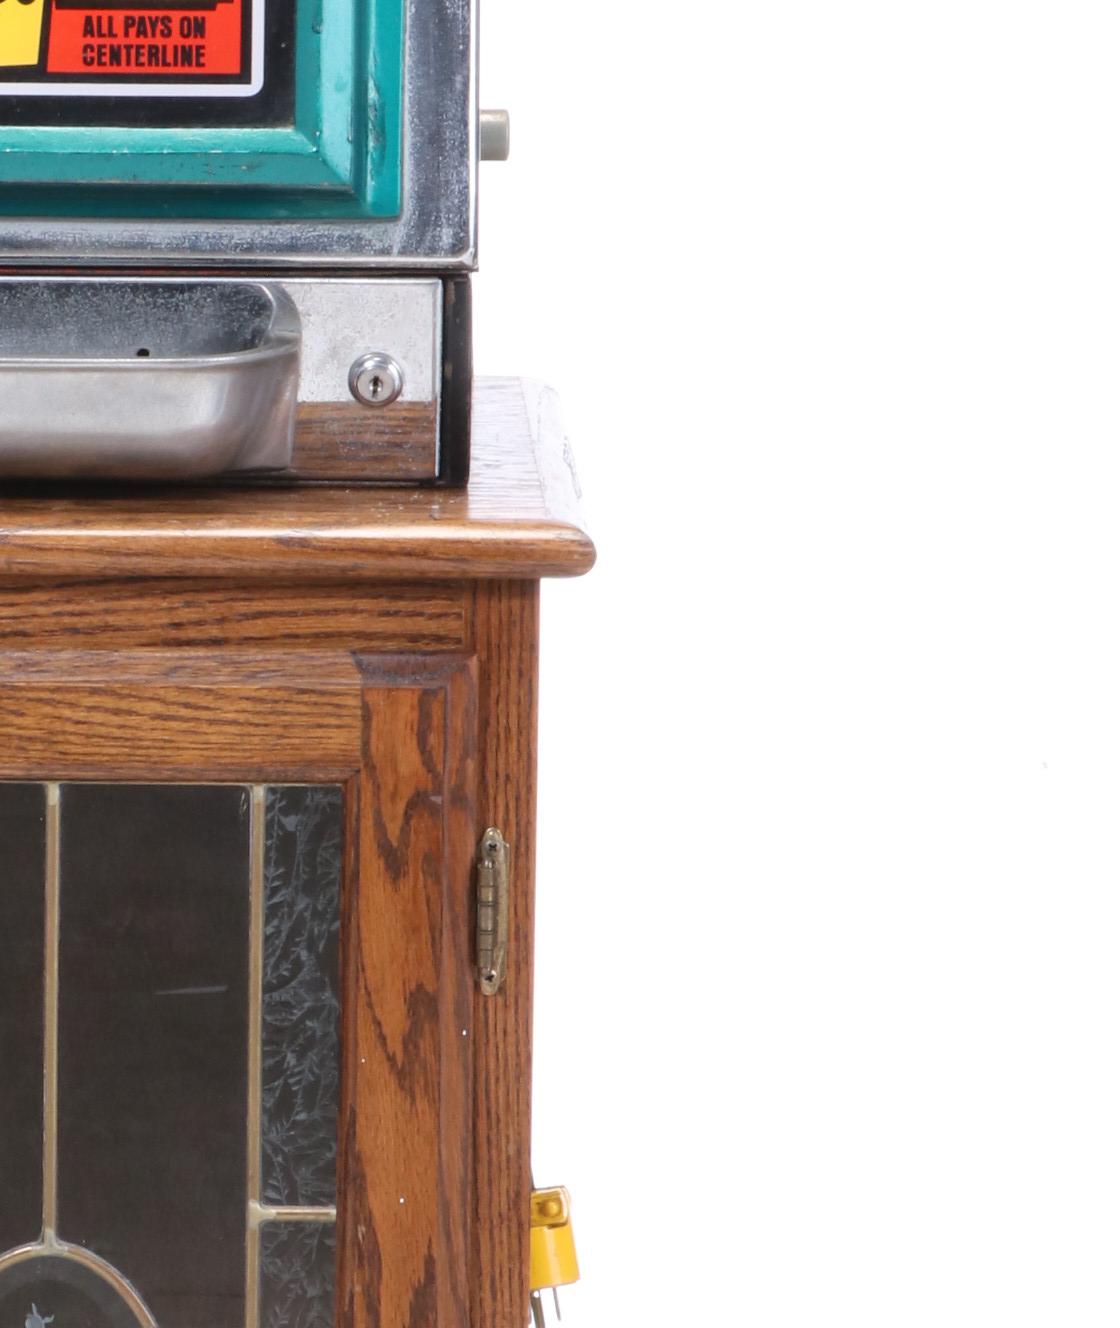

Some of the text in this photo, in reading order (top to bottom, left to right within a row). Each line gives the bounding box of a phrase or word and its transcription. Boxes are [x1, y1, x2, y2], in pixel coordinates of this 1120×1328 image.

[82, 15, 206, 39] ALL PAYS ON
[82, 43, 206, 68] CENTERLINE
